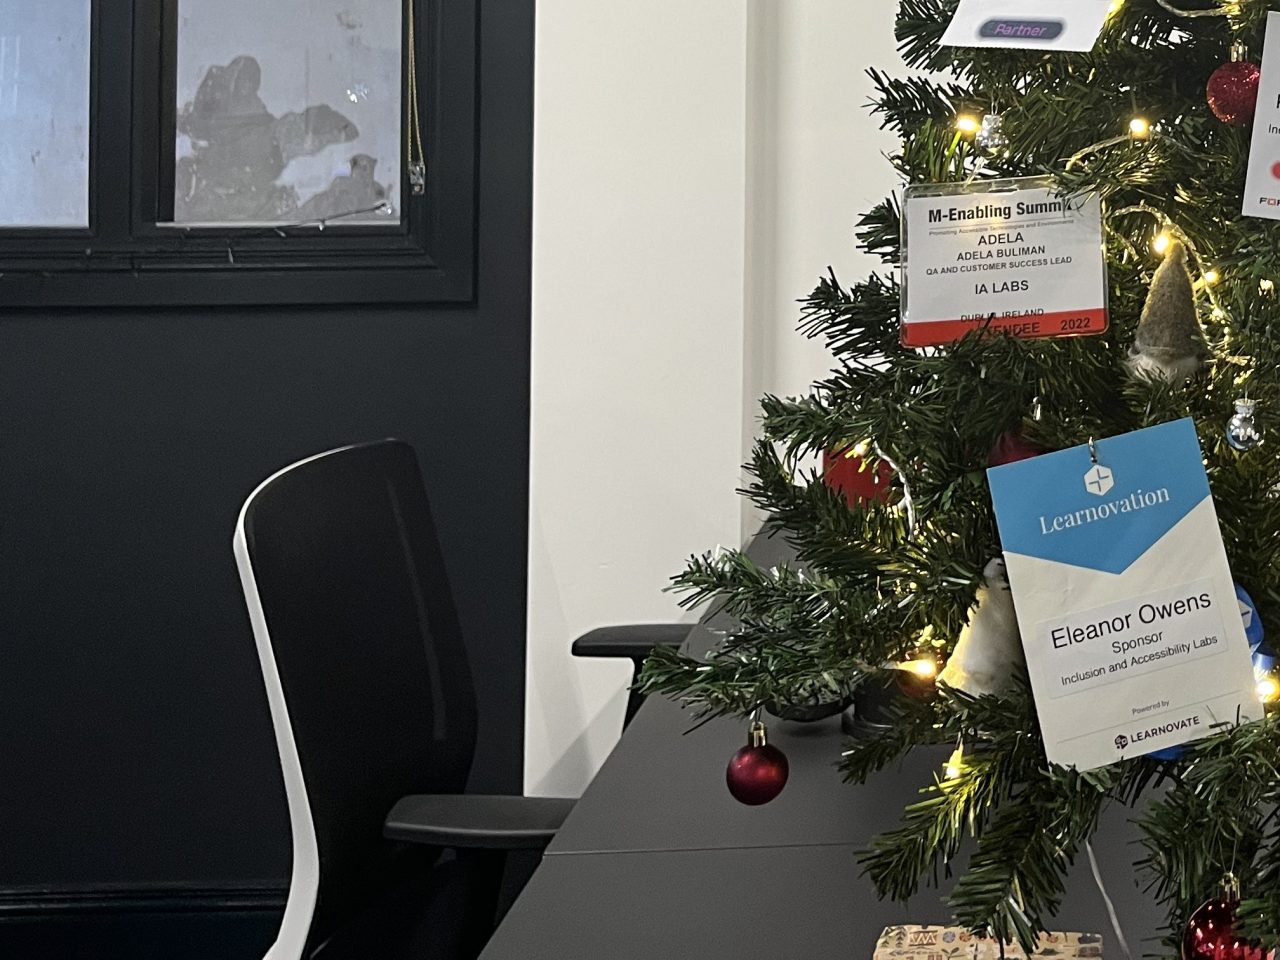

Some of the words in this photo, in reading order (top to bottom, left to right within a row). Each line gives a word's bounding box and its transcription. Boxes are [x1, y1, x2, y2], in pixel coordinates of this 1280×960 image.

[994, 23, 1047, 36] Partner
[928, 204, 1011, 223] M-Enabling
[1016, 200, 1072, 215] Summ
[978, 232, 1024, 246] ADELA
[957, 250, 993, 261] ADELA
[997, 246, 1045, 258] BULIMAN
[926, 267, 938, 276] QA
[941, 265, 959, 274] AND
[960, 262, 1007, 272] CUSTOMER
[1009, 258, 1048, 268] SUCCESS
[1050, 256, 1072, 265] LEAD
[975, 284, 988, 294] IA
[993, 280, 1029, 293] LABS
[1002, 308, 1044, 319] IRELAND
[1061, 317, 1090, 331] 2022
[1039, 487, 1170, 535] Learnovation
[1051, 614, 1132, 649] Eleanor
[1139, 593, 1212, 624] Owens
[1112, 631, 1163, 654] Sponsor
[1061, 666, 1106, 686] Inclusion
[1109, 659, 1127, 673] and
[1131, 643, 1191, 667] Accessibility
[1193, 635, 1218, 649] Labs
[1132, 702, 1161, 715] Powered
[1161, 700, 1170, 708] by
[1130, 716, 1200, 743] LEARNOVATE
